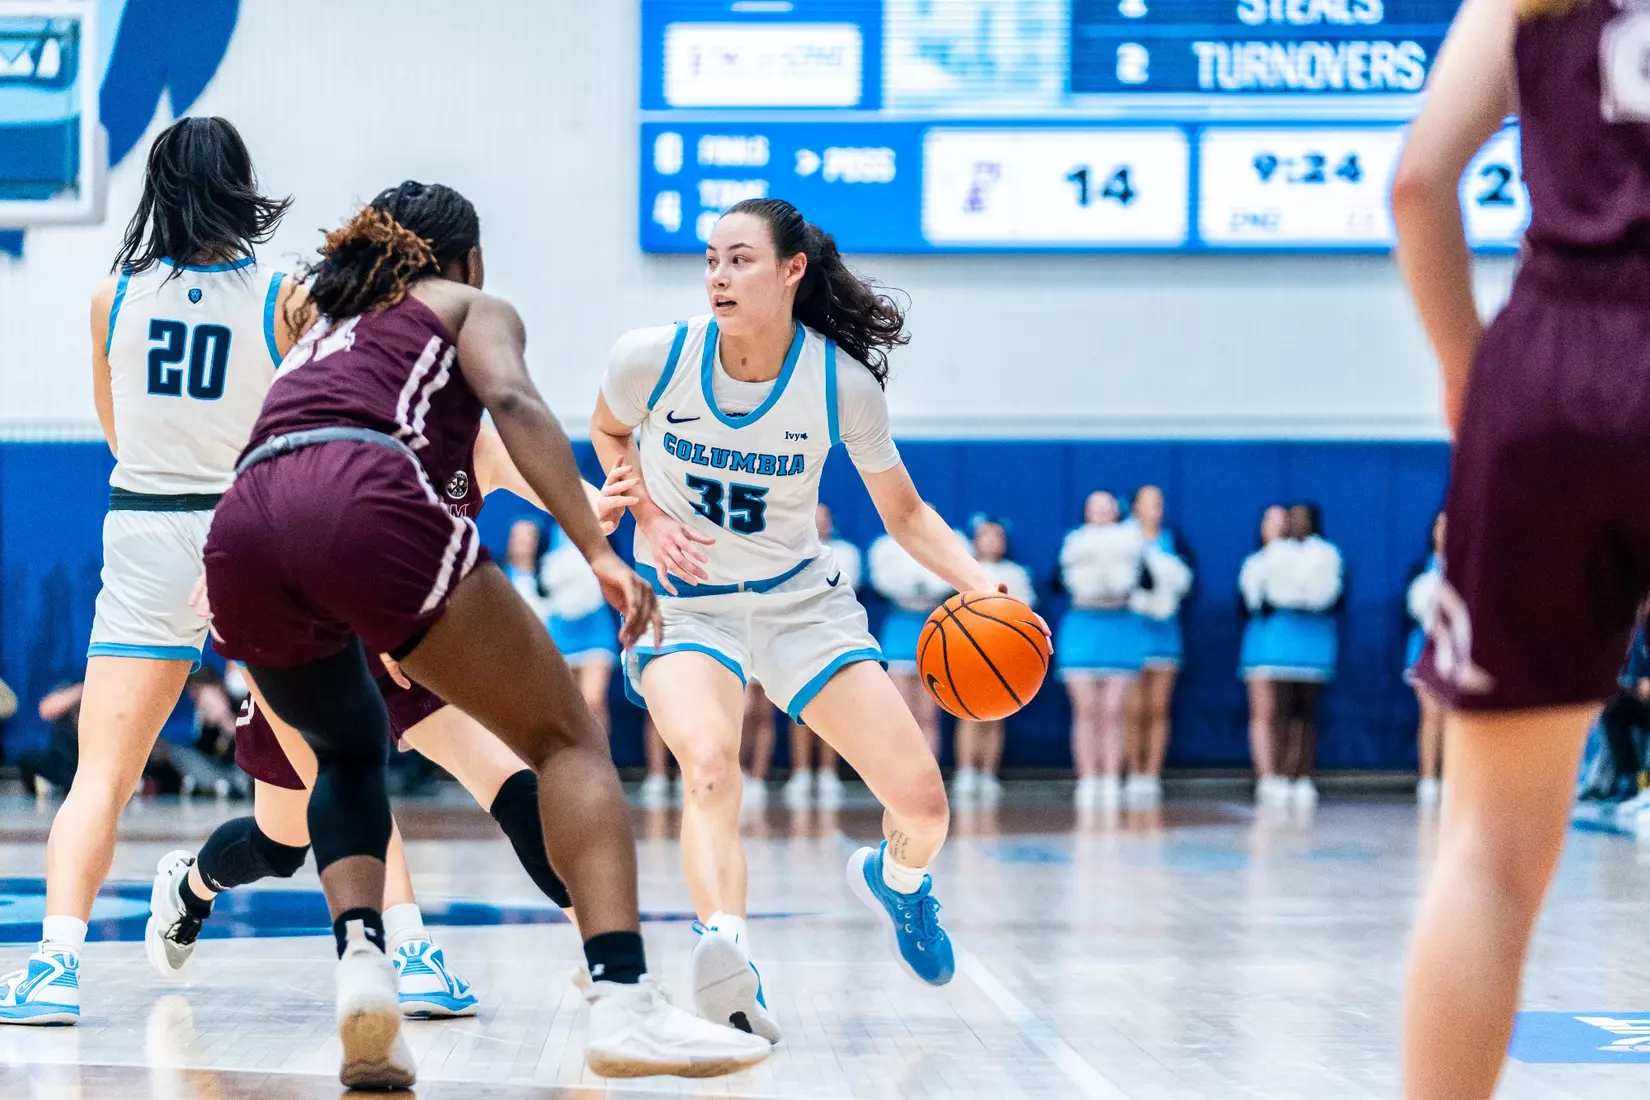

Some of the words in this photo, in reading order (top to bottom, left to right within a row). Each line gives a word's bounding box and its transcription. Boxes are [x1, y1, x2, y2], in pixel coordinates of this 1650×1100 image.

[1193, 40, 1426, 91] TURNOVERS
[1066, 163, 1139, 207] 14
[1251, 150, 1364, 184] 9:24
[147, 317, 232, 401] 20
[663, 432, 805, 477] COLUMBIA
[784, 430, 800, 442] Ivy
[685, 472, 769, 535] 35
